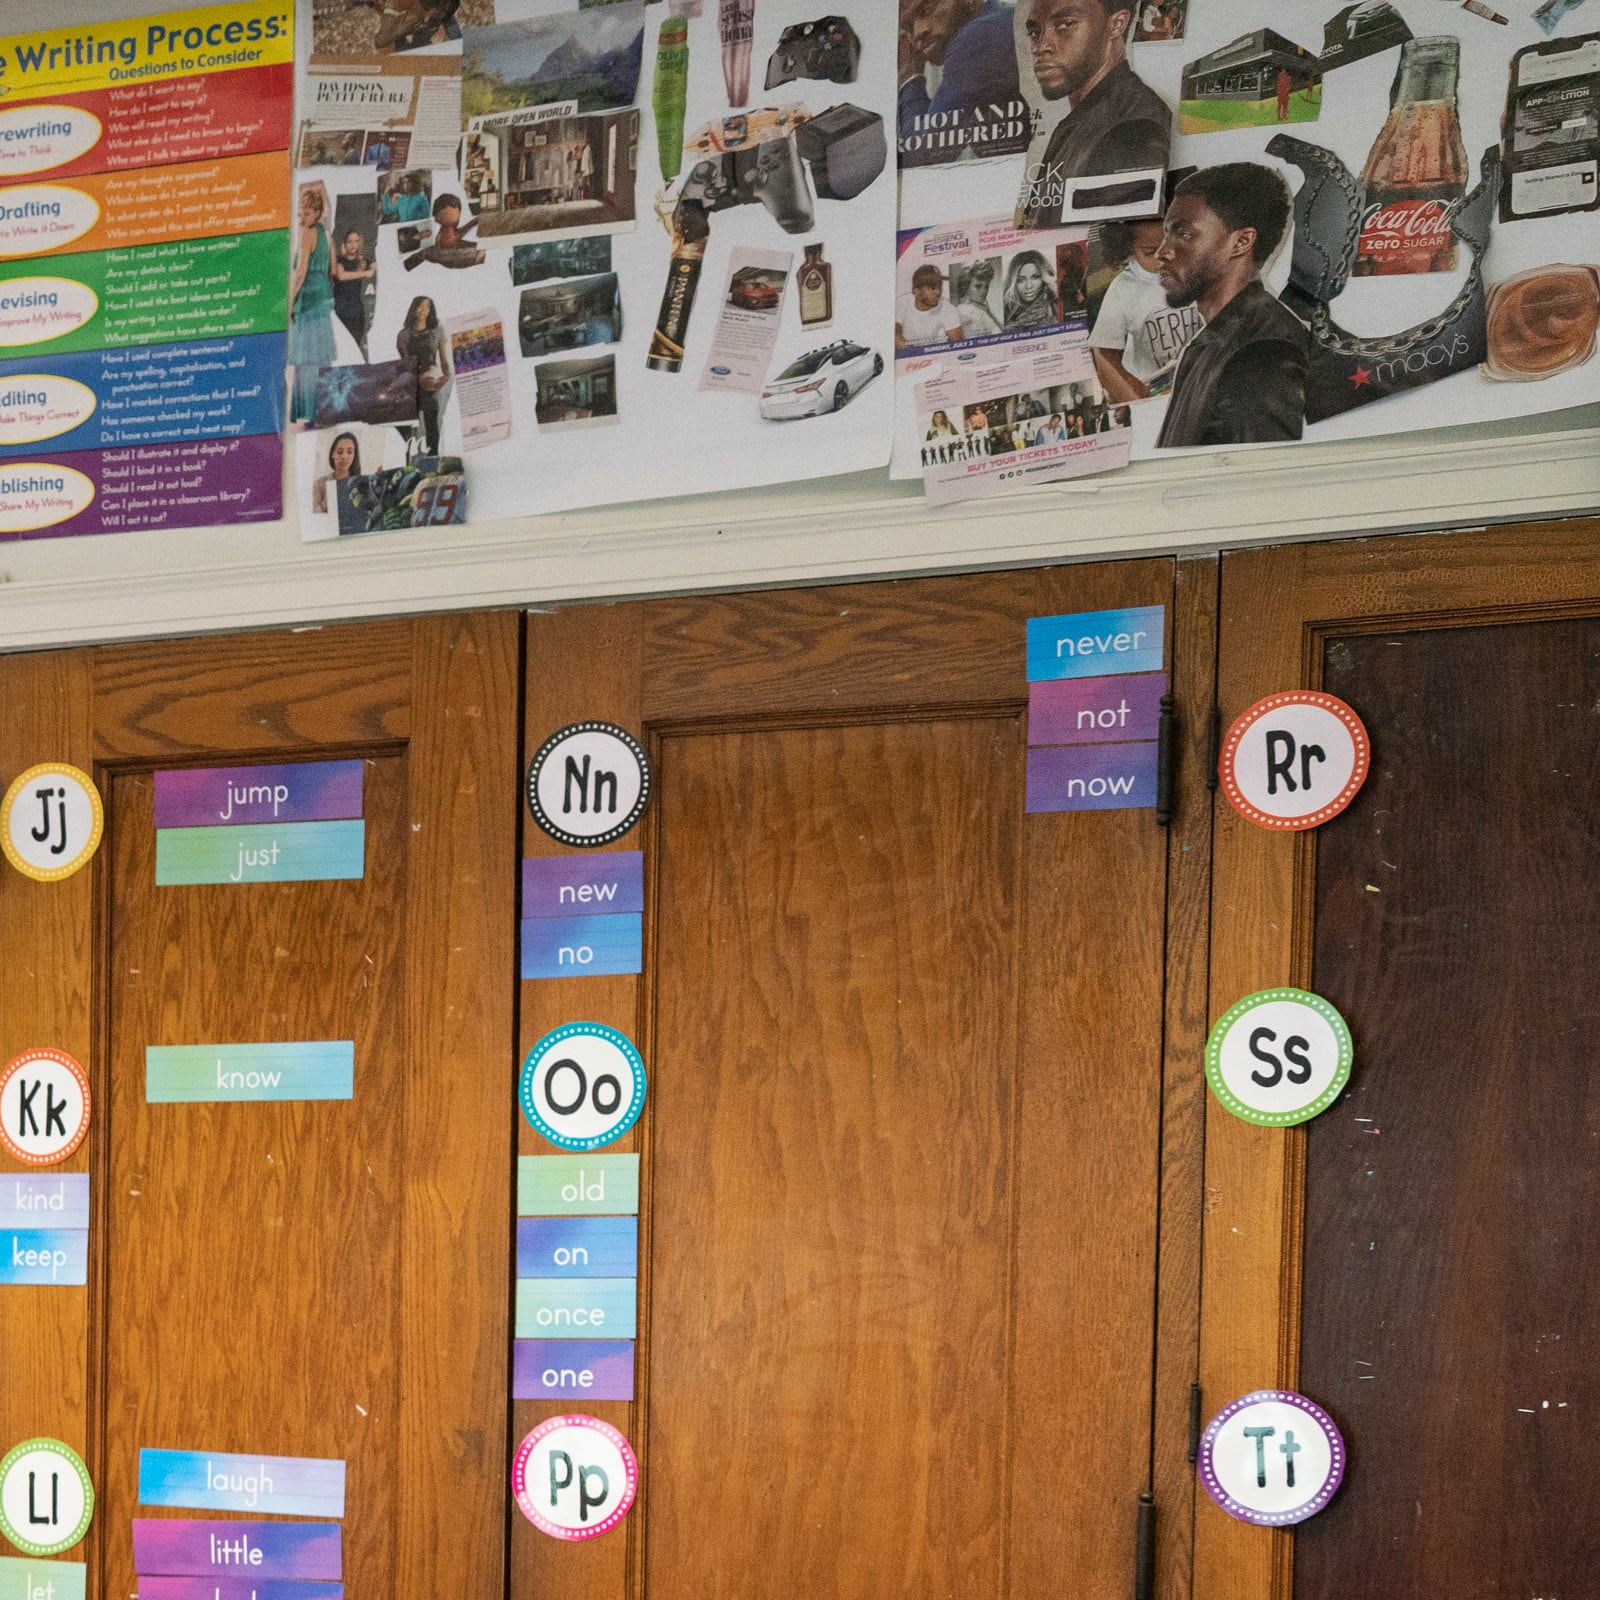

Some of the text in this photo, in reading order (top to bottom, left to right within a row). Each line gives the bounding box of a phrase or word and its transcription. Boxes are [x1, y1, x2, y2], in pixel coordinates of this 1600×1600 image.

[15, 35, 136, 72] Writing
[147, 14, 288, 54] Process:
[109, 49, 262, 80] Questions to Consider
[474, 121, 479, 131] A
[512, 109, 535, 123] OPEN
[538, 106, 571, 120] WORLD
[914, 101, 1024, 131] HOT AND
[17, 149, 26, 158] to
[1366, 237, 1444, 250] zero SUGAR
[1377, 333, 1469, 382] macy's
[990, 457, 1016, 468] YOUR
[1020, 447, 1059, 464] TICKETS
[1063, 439, 1097, 451] TODAY!
[0, 502, 21, 512] Share
[25, 499, 40, 512] My
[42, 498, 73, 509] Writing
[102, 484, 126, 495] Should
[137, 482, 154, 492] read
[166, 480, 179, 489] out
[182, 477, 202, 487] loud?
[1056, 627, 1146, 657] never
[1266, 730, 1326, 795] Rr
[220, 780, 288, 819] jump
[562, 754, 618, 814] Nn
[31, 788, 67, 855] Jj
[231, 840, 280, 881] just
[559, 879, 618, 904] new
[1249, 1027, 1311, 1087] Ss
[19, 1079, 67, 1136] Kk
[544, 1058, 621, 1115] Oo
[13, 1237, 66, 1280] keep
[1243, 1426, 1301, 1488] Tt
[28, 1471, 58, 1525] Ll
[207, 1460, 273, 1507] laugh
[549, 1450, 609, 1521] Pp
[211, 1534, 263, 1565] little
